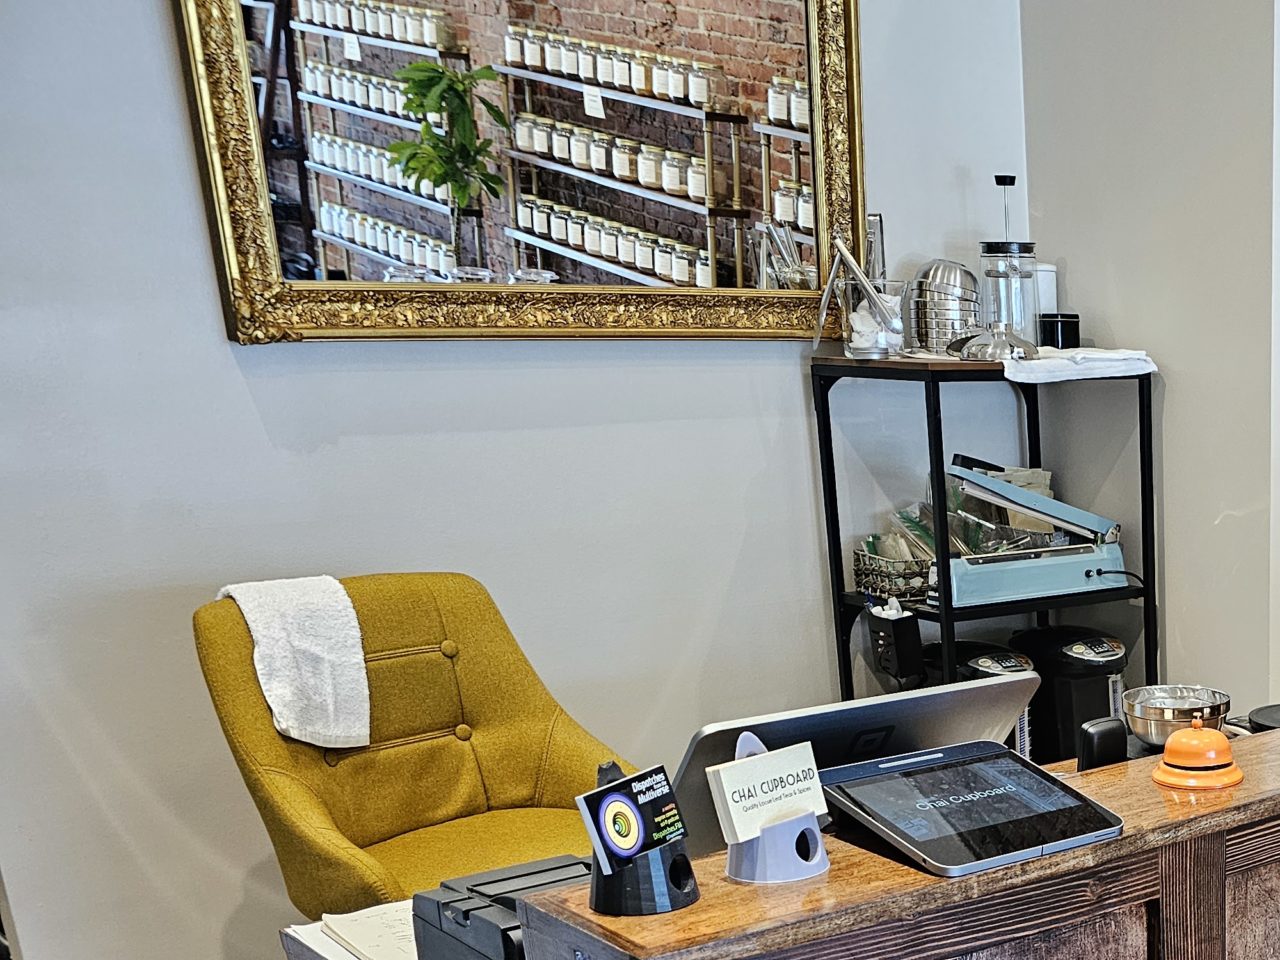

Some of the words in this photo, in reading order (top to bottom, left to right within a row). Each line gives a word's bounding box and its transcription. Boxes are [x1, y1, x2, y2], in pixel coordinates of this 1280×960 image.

[632, 773, 665, 793] Dispatches
[638, 785, 670, 805] Multiverse
[731, 784, 758, 804] CHAI
[760, 767, 815, 795] CUPBOARD
[742, 803, 759, 813] Quality
[772, 794, 783, 803] Leaf
[782, 792, 793, 800] Teas
[797, 786, 812, 796] Spices
[915, 793, 949, 812] Chai
[949, 783, 1017, 805] Cupboard
